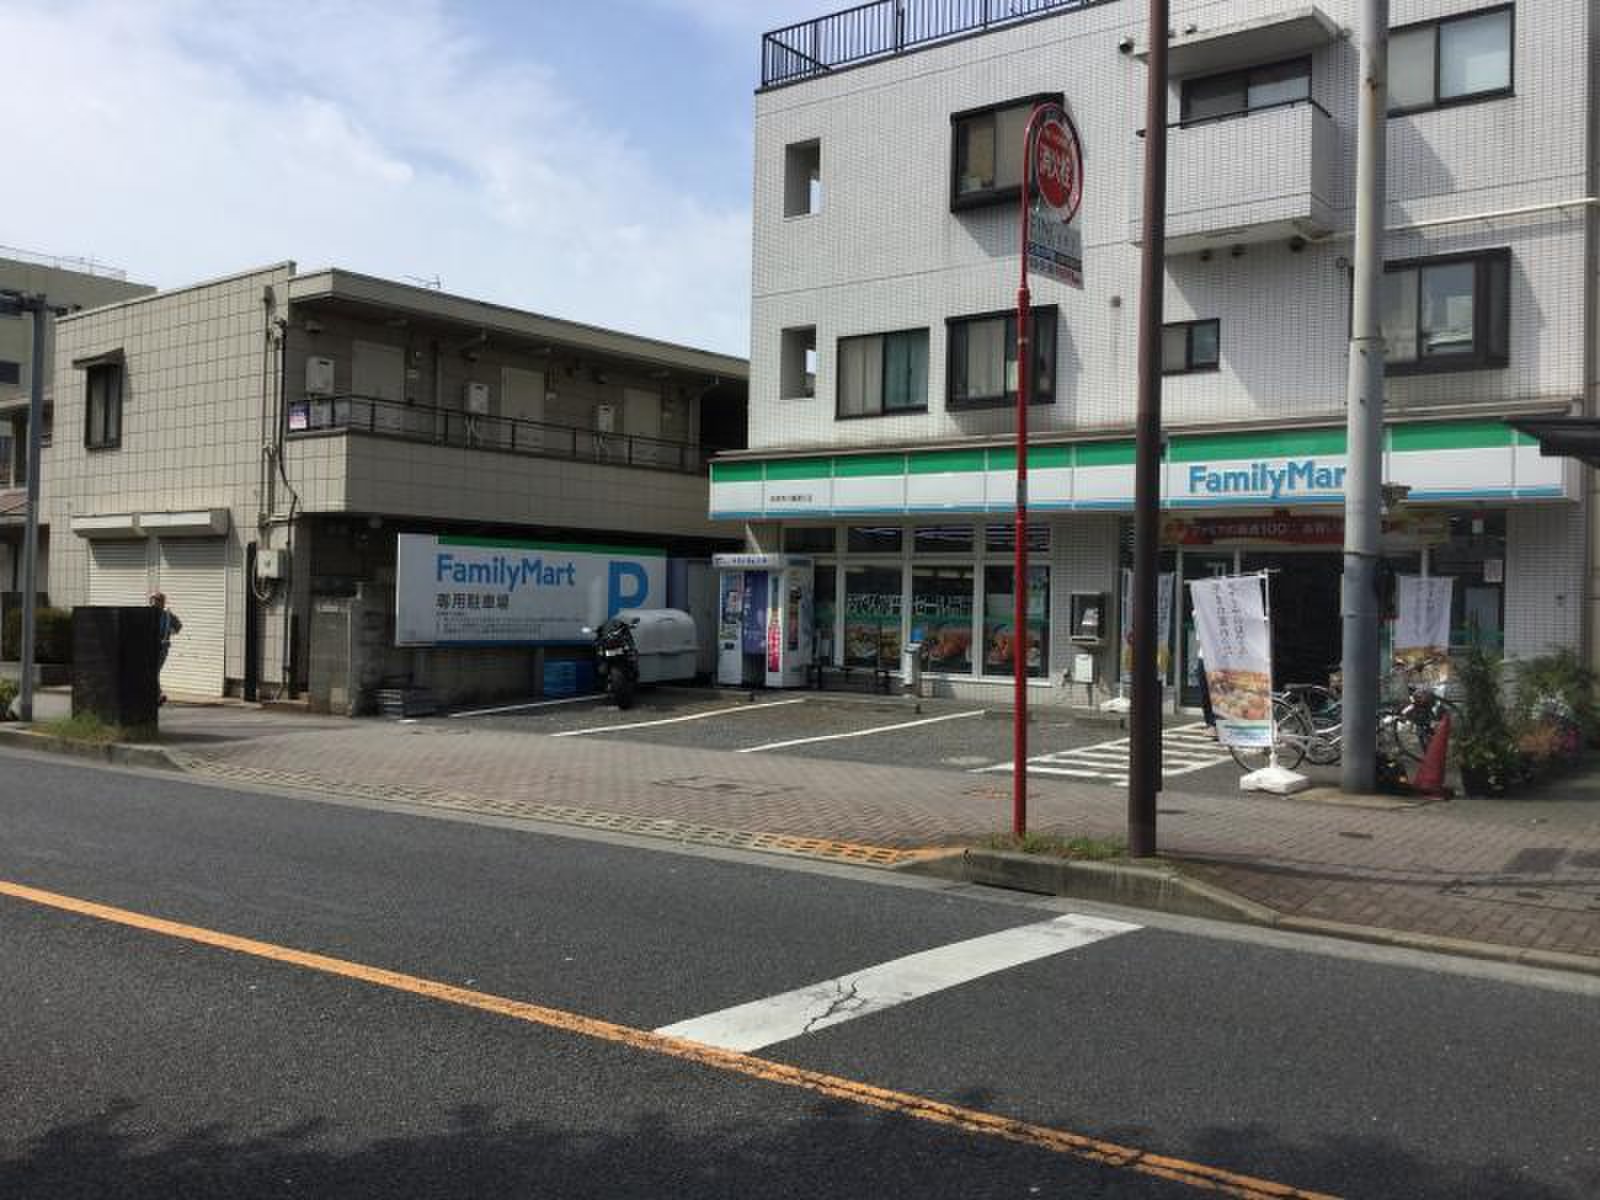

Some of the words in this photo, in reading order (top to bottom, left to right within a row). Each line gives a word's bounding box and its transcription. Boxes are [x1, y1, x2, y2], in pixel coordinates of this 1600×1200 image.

[1188, 460, 1346, 499] FamilyMar
[436, 553, 576, 592] FamilyMart
[608, 560, 648, 621] P
